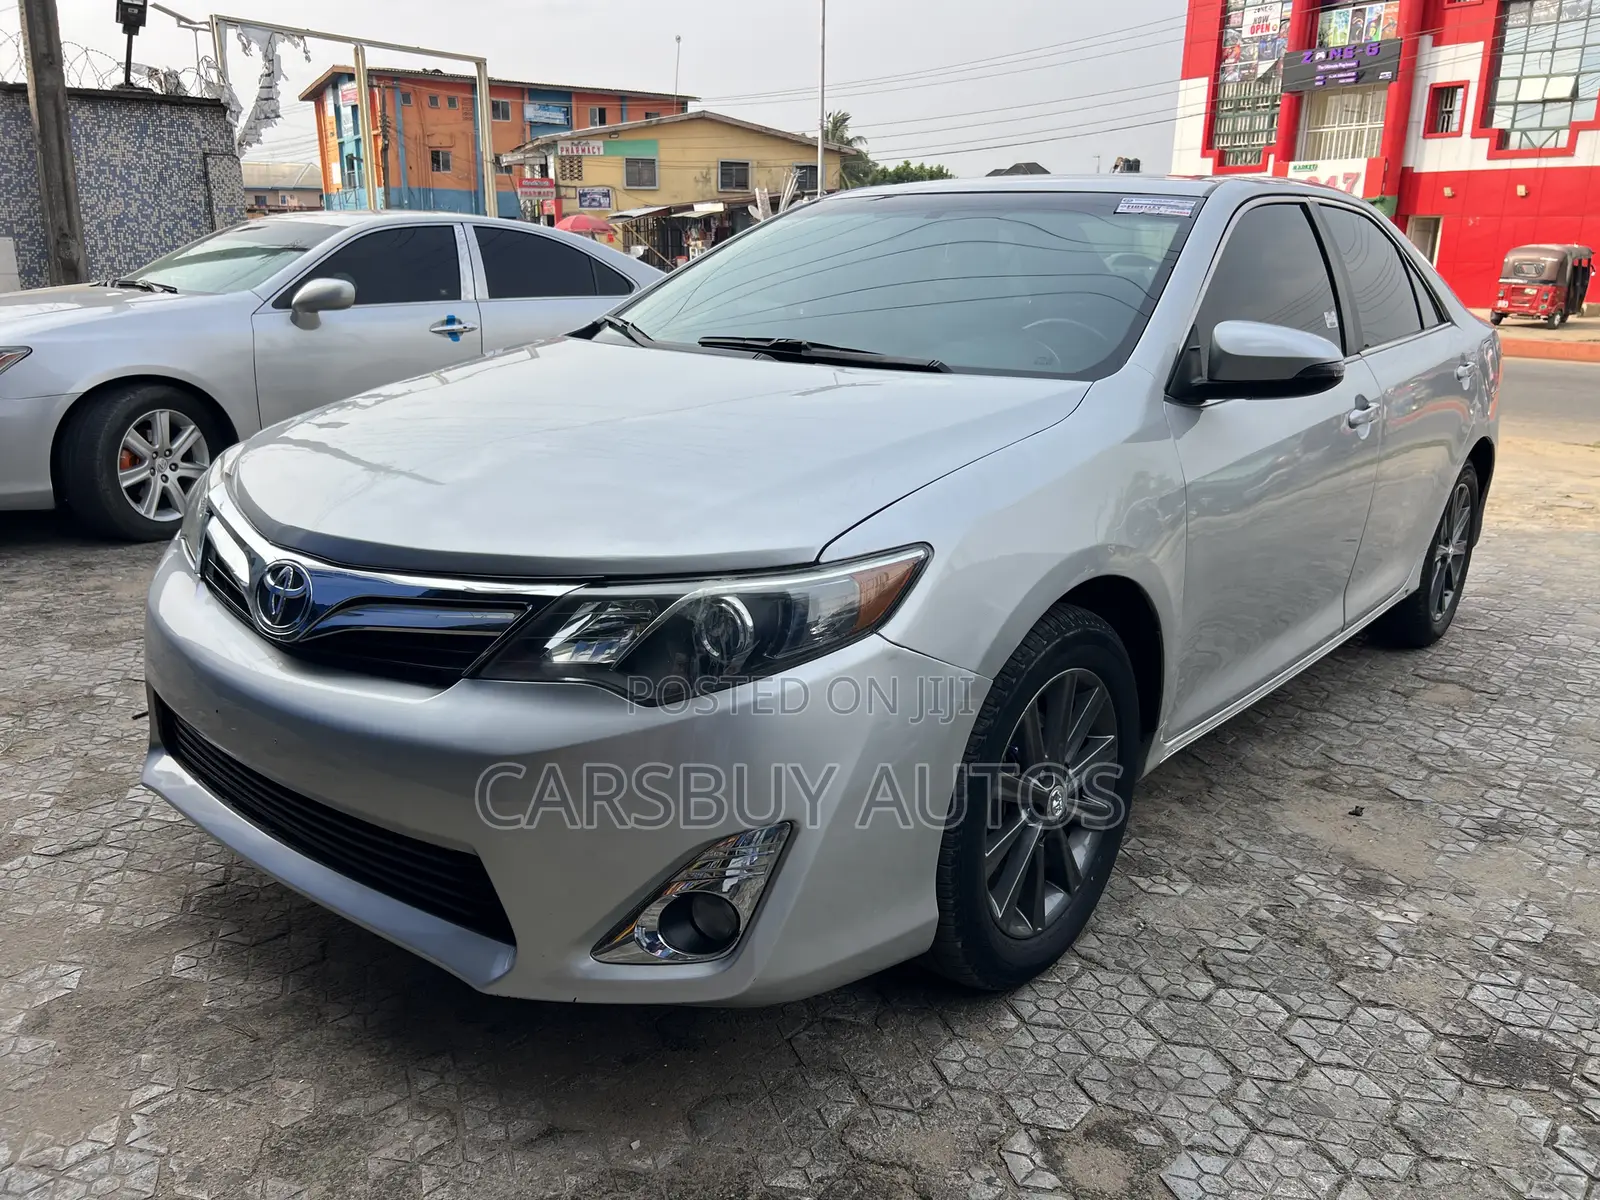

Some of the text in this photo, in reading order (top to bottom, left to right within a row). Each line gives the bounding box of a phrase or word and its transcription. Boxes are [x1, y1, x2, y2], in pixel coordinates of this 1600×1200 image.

[1252, 15, 1270, 25] NOW
[1250, 22, 1271, 35] OPEN
[560, 146, 601, 155] PHARMACY
